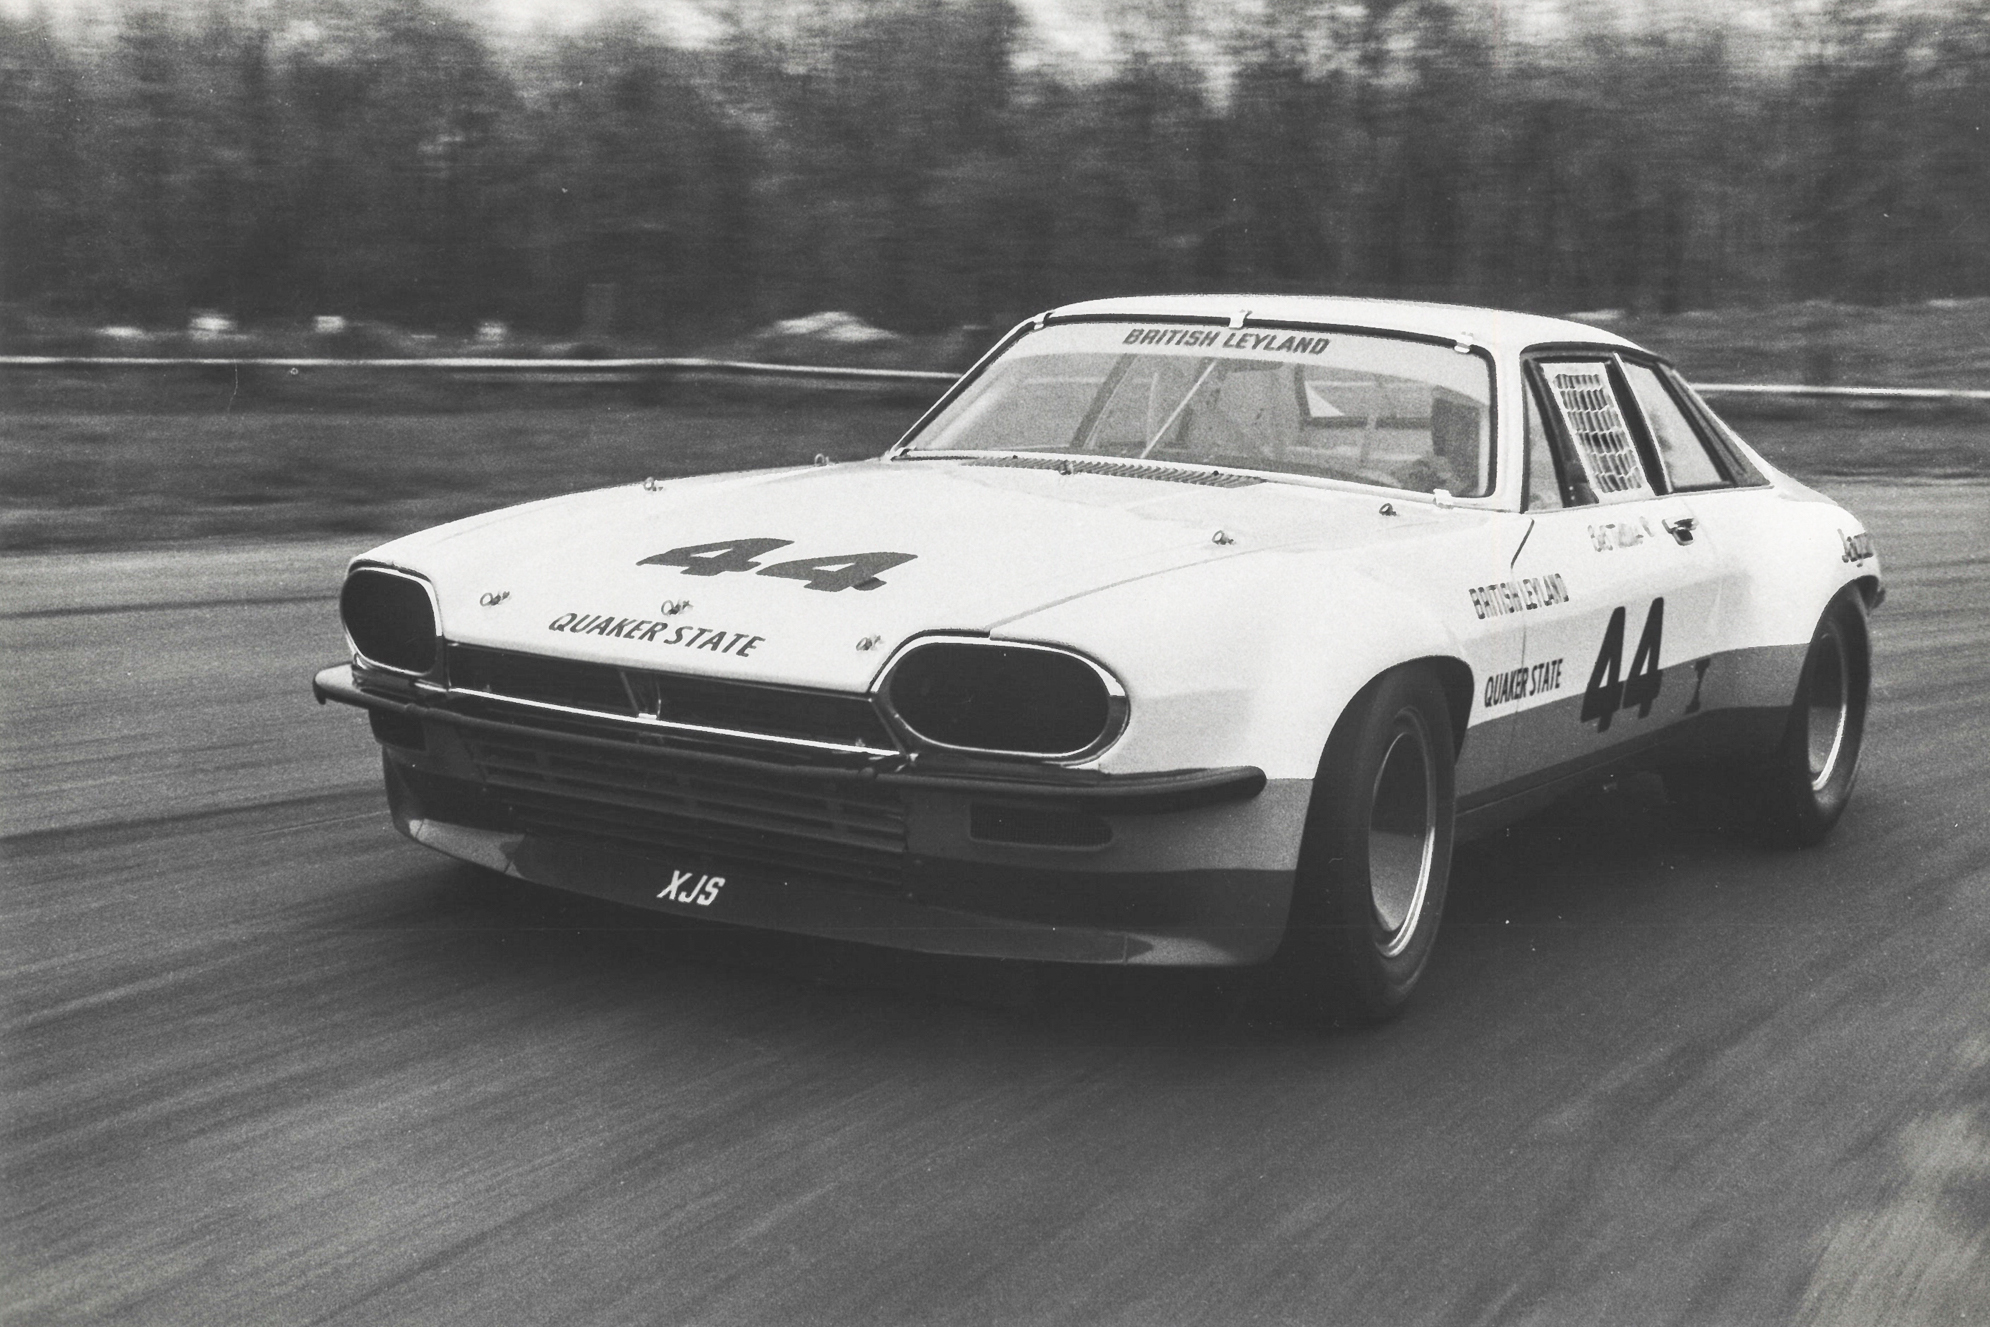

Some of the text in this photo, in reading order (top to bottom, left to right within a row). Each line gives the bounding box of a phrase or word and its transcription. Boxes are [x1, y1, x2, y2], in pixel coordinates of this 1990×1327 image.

[1122, 328, 1331, 356] BRITISH LEYLAND
[636, 537, 918, 592] 44
[1468, 581, 1523, 619] BRITISH
[548, 612, 765, 657] QUAKER STATE
[1484, 658, 1563, 708] QUAKER STATE
[1580, 597, 1664, 733] 44
[656, 870, 726, 906] XJS
